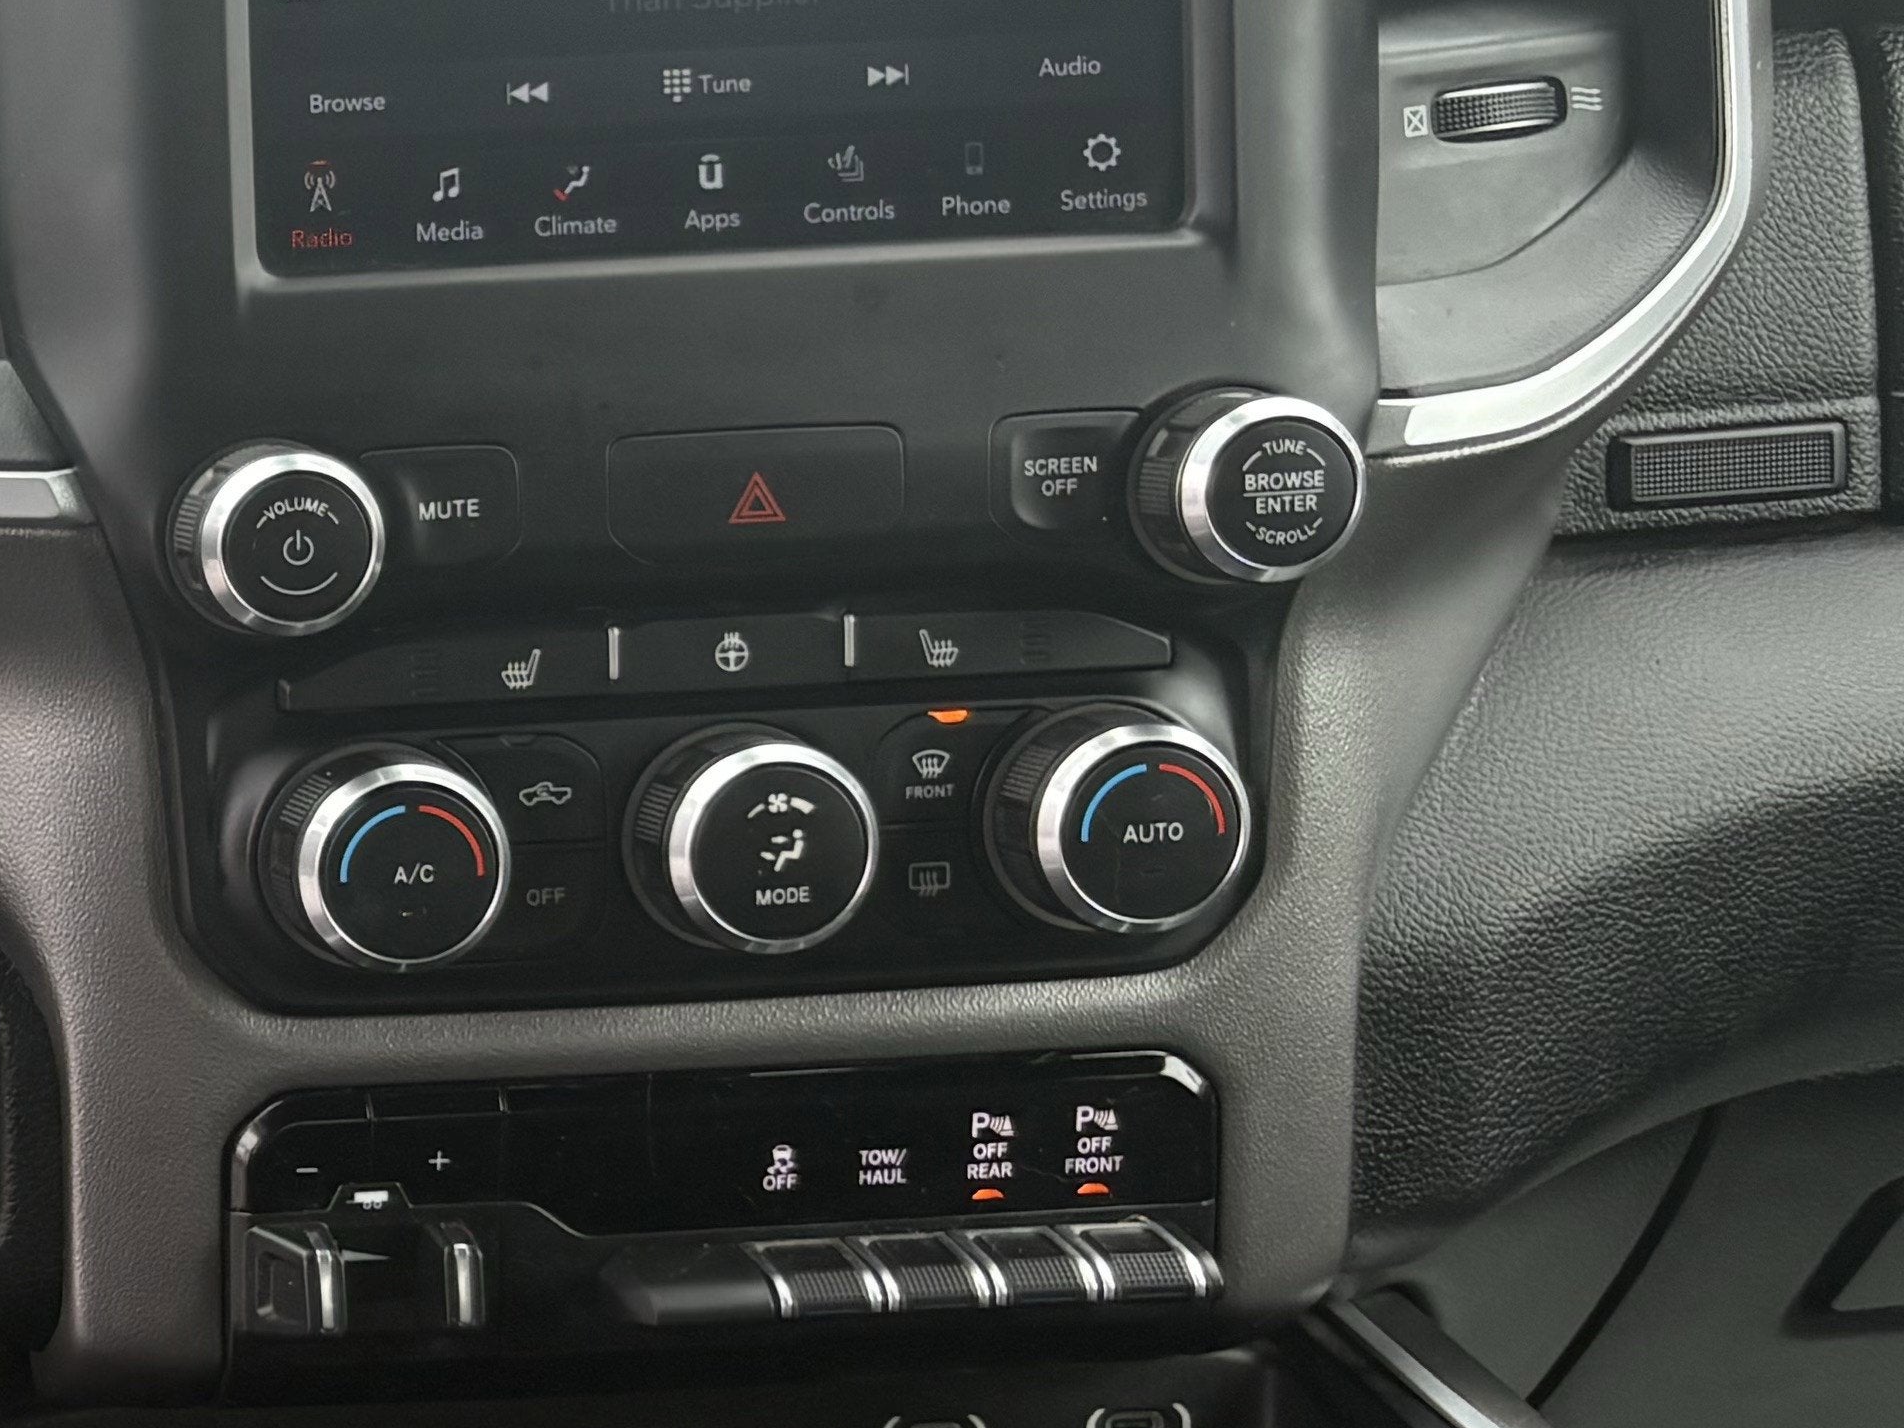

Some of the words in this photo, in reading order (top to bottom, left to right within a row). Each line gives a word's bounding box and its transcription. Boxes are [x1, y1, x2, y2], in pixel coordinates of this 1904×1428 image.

[1039, 56, 1101, 78] Audio
[698, 74, 751, 93] Tune
[310, 94, 386, 114] Browse
[804, 200, 895, 224] Controls
[942, 196, 1011, 217] Phone
[1060, 190, 1148, 214] Settings
[535, 214, 617, 238] Climate
[684, 210, 740, 231] Apps
[292, 229, 352, 247] Radio
[416, 222, 484, 242] Media
[1262, 438, 1306, 456] TUNE
[1024, 456, 1098, 477] SCREEN
[1041, 478, 1078, 497] OFF
[1244, 470, 1325, 491] BROWSE
[264, 497, 329, 520] VOLUME
[419, 498, 480, 521] MUTE
[1255, 494, 1318, 515] ENTER
[1255, 523, 1317, 546] SCROLL
[905, 783, 955, 800] FRONT
[1123, 822, 1184, 844] AUTO
[393, 863, 435, 885] A/C
[526, 887, 566, 907] OFF
[756, 886, 810, 906] MODE
[972, 1143, 1007, 1160] OFF
[1077, 1137, 1112, 1155] OFF
[859, 1148, 907, 1167] TOW/
[1065, 1156, 1124, 1174] FRONT
[859, 1169, 906, 1187] HAUL
[967, 1161, 1013, 1180] REAR
[763, 1173, 798, 1192] OFF
